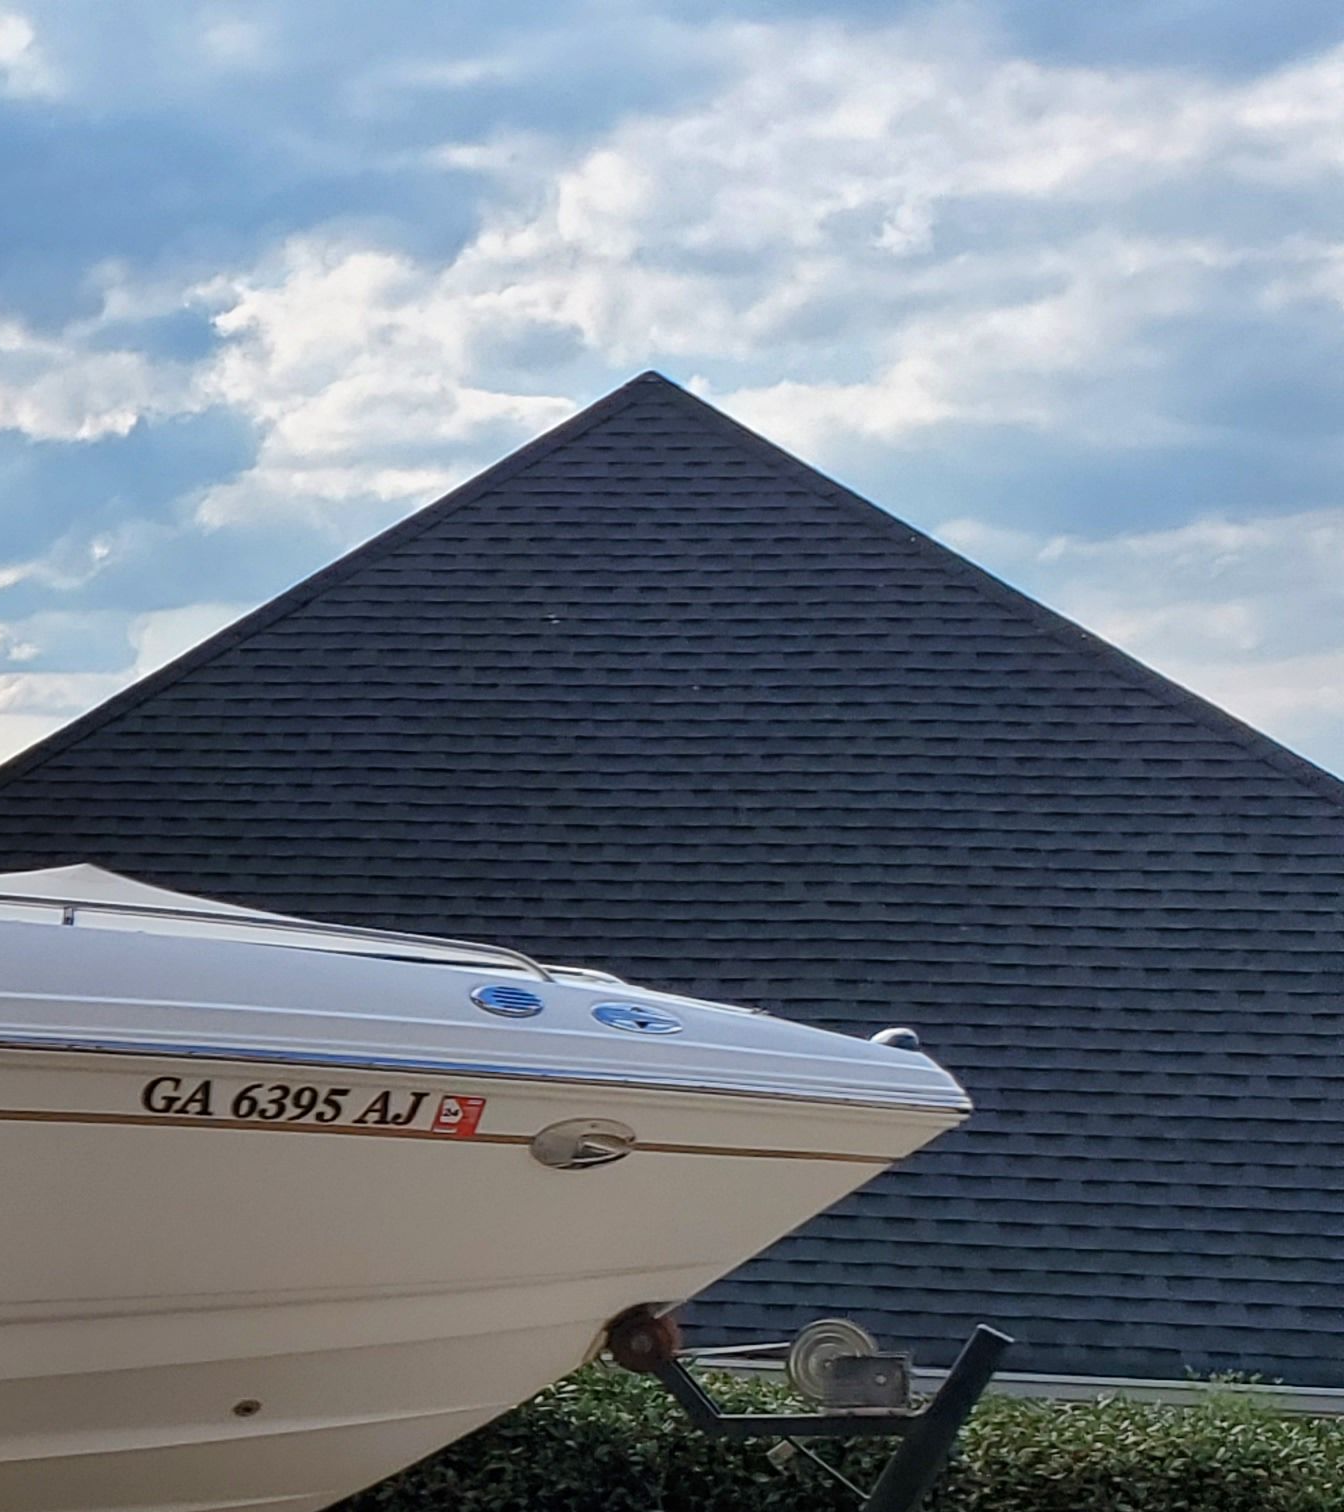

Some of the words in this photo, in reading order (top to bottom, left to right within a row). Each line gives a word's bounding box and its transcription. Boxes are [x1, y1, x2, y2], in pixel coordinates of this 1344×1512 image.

[141, 1076, 213, 1116] GA
[230, 1082, 351, 1123] 6395
[352, 1089, 431, 1126] AJ
